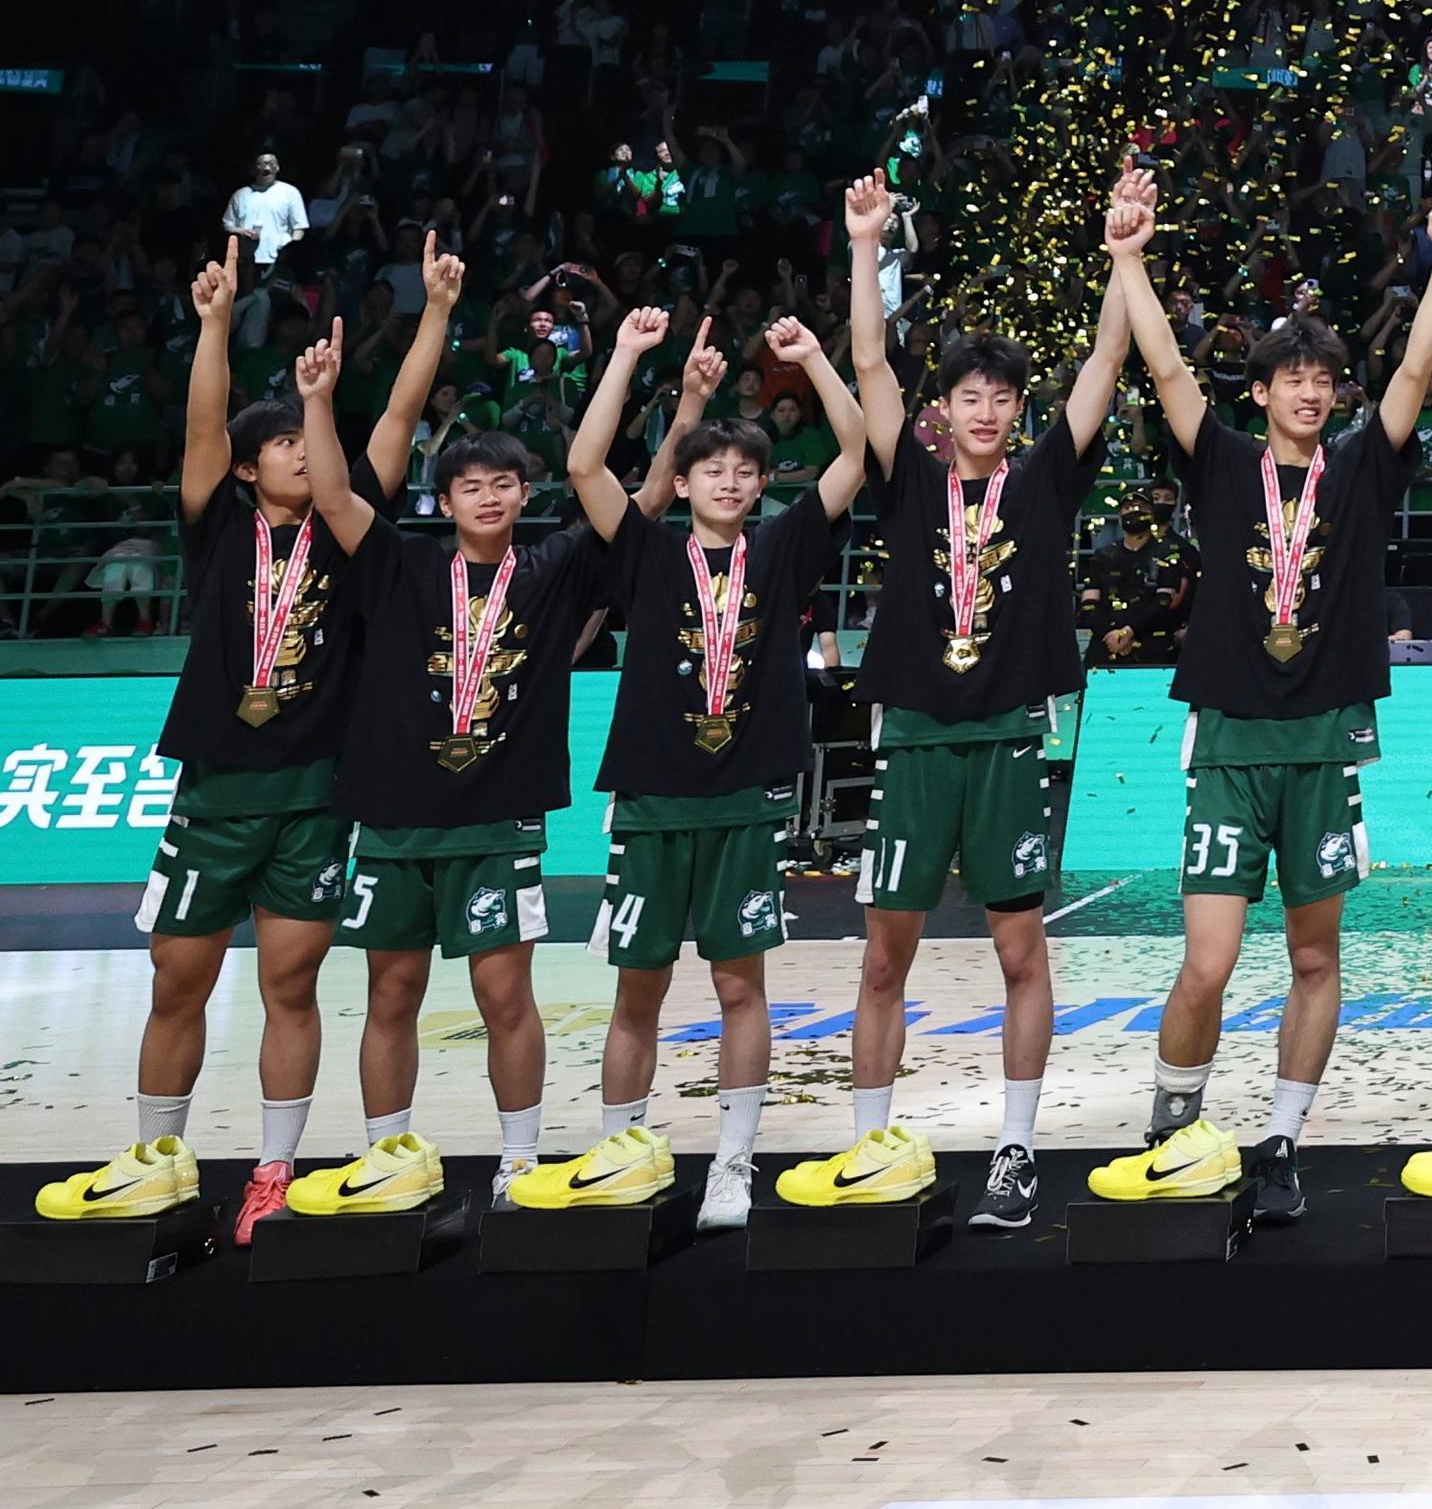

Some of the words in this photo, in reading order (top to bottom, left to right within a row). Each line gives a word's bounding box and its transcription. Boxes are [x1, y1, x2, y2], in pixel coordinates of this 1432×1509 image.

[1187, 824, 1243, 876] 35
[175, 869, 200, 920] 1
[341, 875, 379, 929] 5
[611, 893, 646, 949] 4
